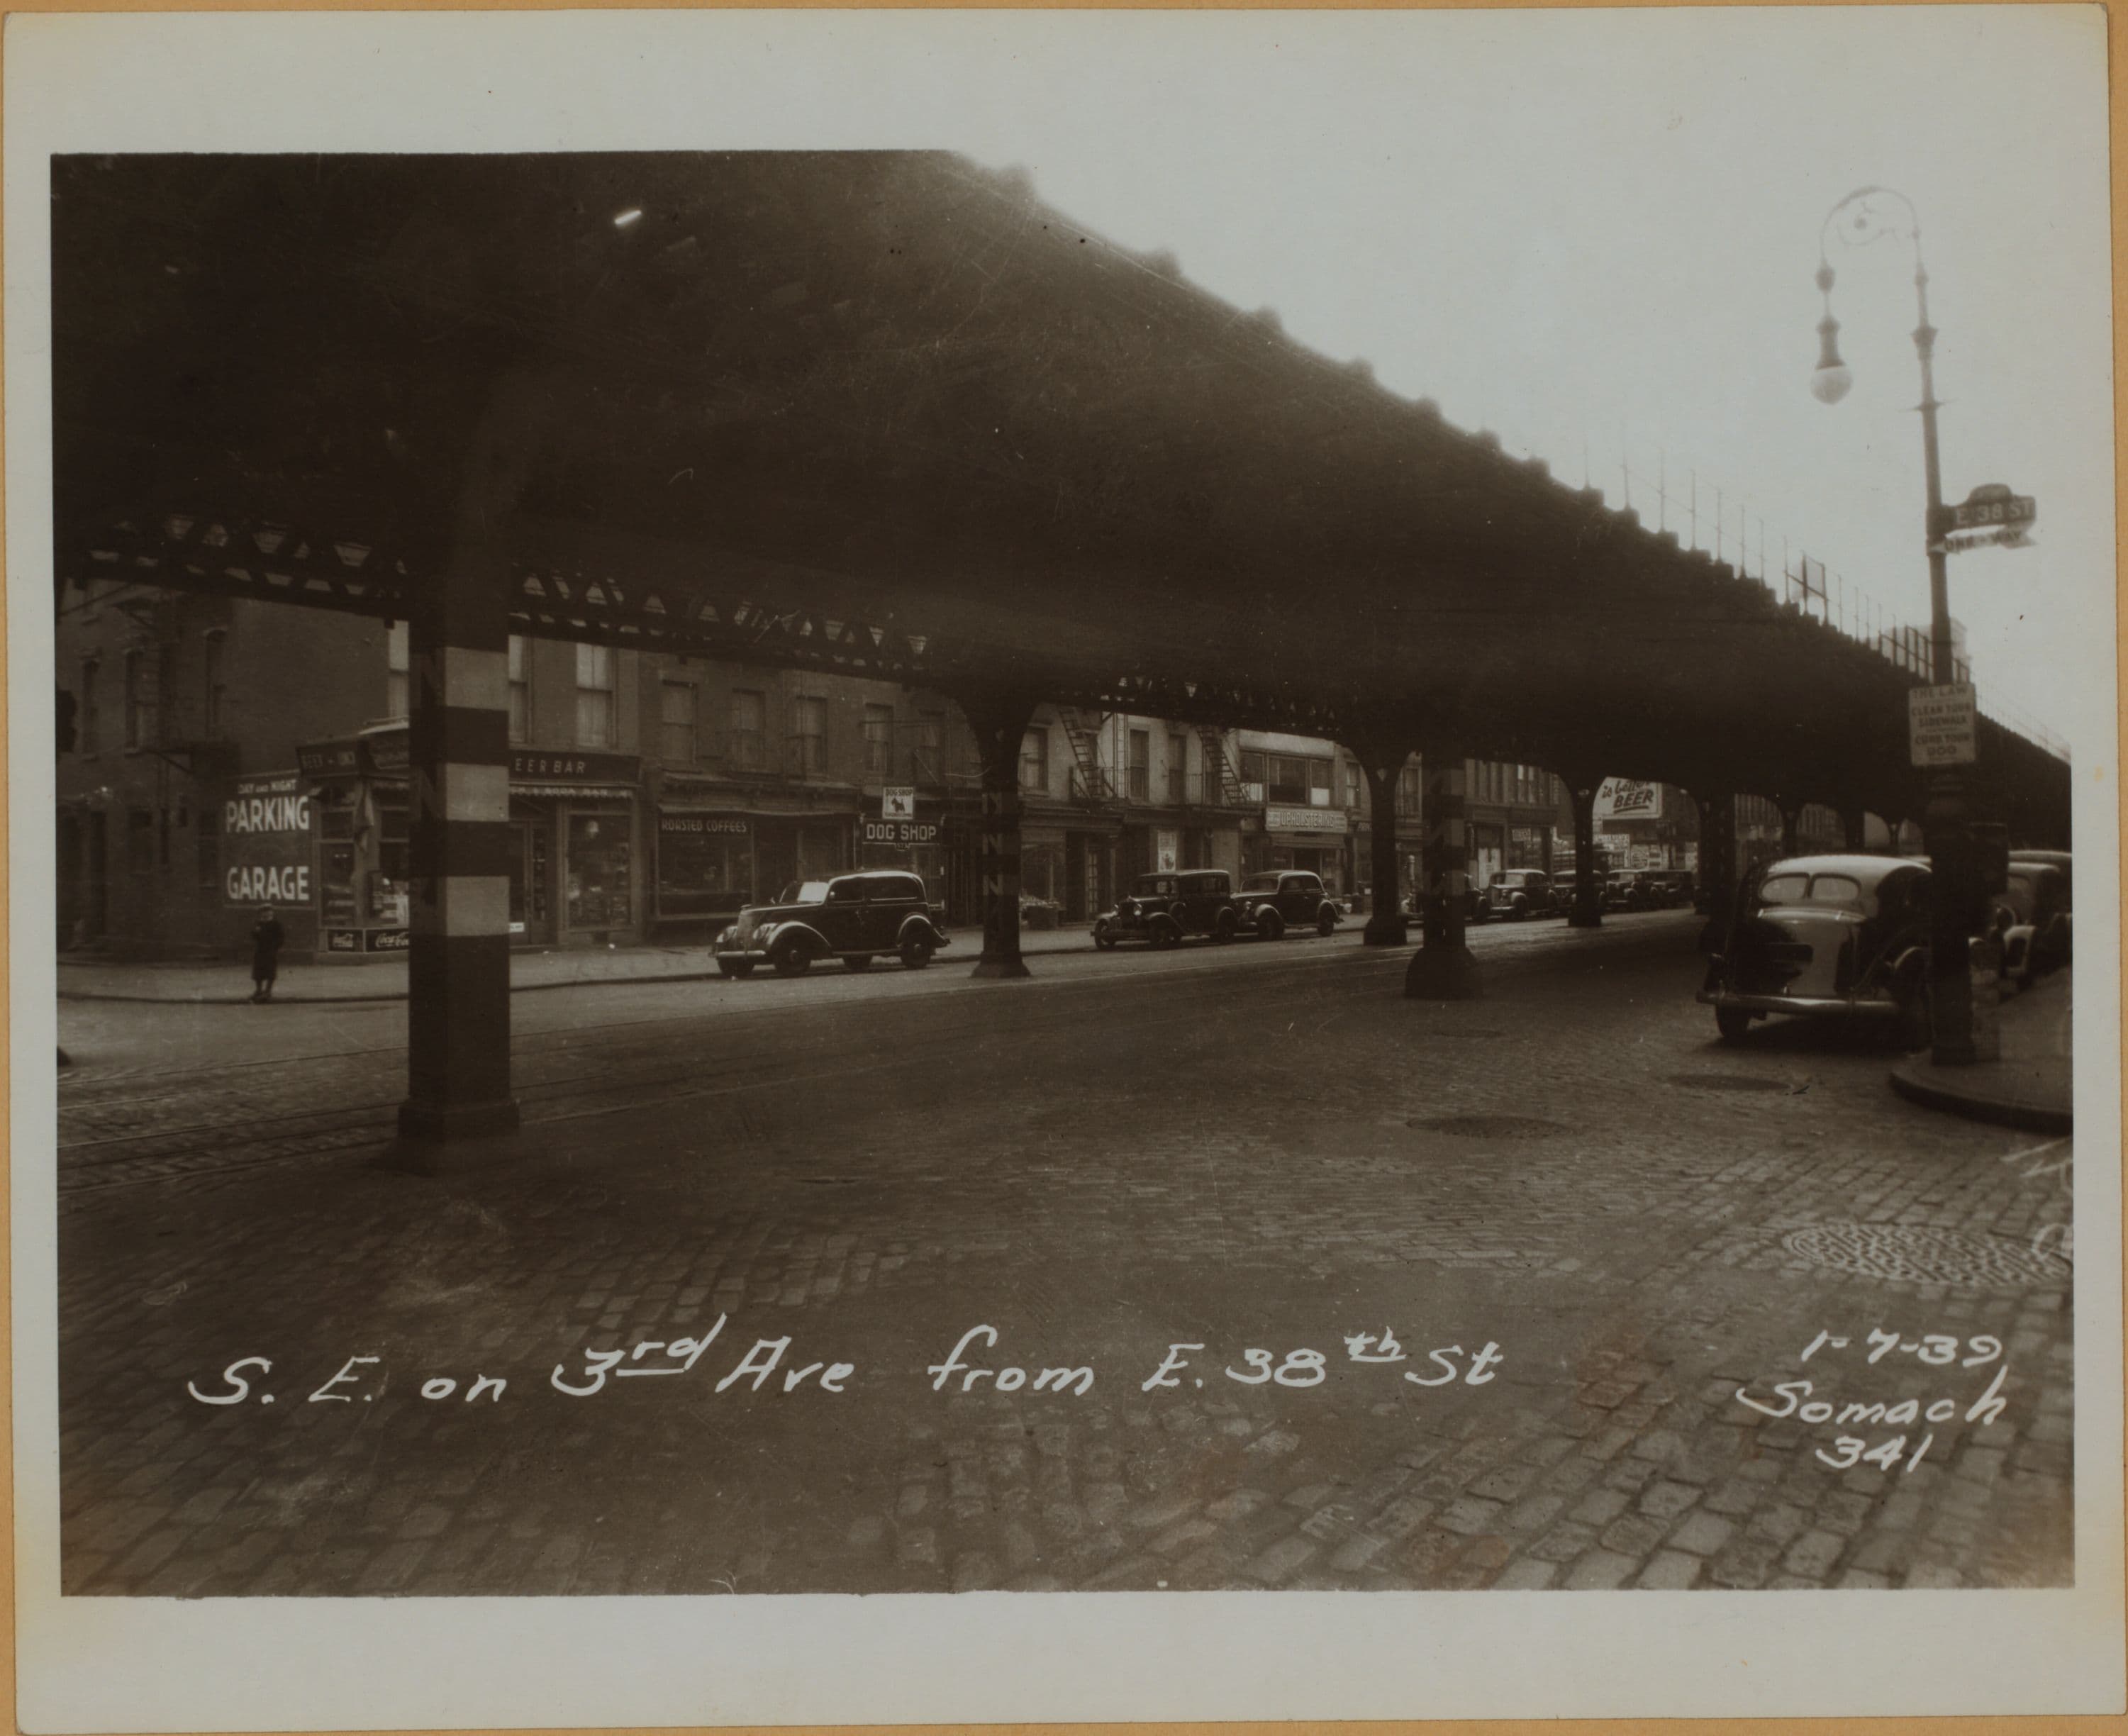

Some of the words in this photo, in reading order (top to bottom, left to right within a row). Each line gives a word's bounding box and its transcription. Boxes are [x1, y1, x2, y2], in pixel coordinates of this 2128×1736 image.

[1956, 507, 1968, 525] E
[1978, 503, 2002, 523] 38
[2009, 500, 2033, 518] ST
[1911, 704, 1944, 716] CLEAN
[515, 757, 547, 773] EER
[553, 760, 586, 774] BAR
[238, 783, 255, 794] DAY
[270, 779, 296, 791] NIGHT
[885, 788, 898, 796] DOG
[898, 788, 913, 796] SHOP
[1614, 789, 1654, 808] BEER
[226, 796, 310, 833] PARKING
[1281, 811, 1334, 828] UPHOLSTERING
[662, 818, 703, 832] ROASTED
[706, 819, 747, 833] COFFEES
[866, 823, 896, 840] DOG
[900, 824, 937, 840] SHOP
[226, 866, 311, 901] GARAGE
